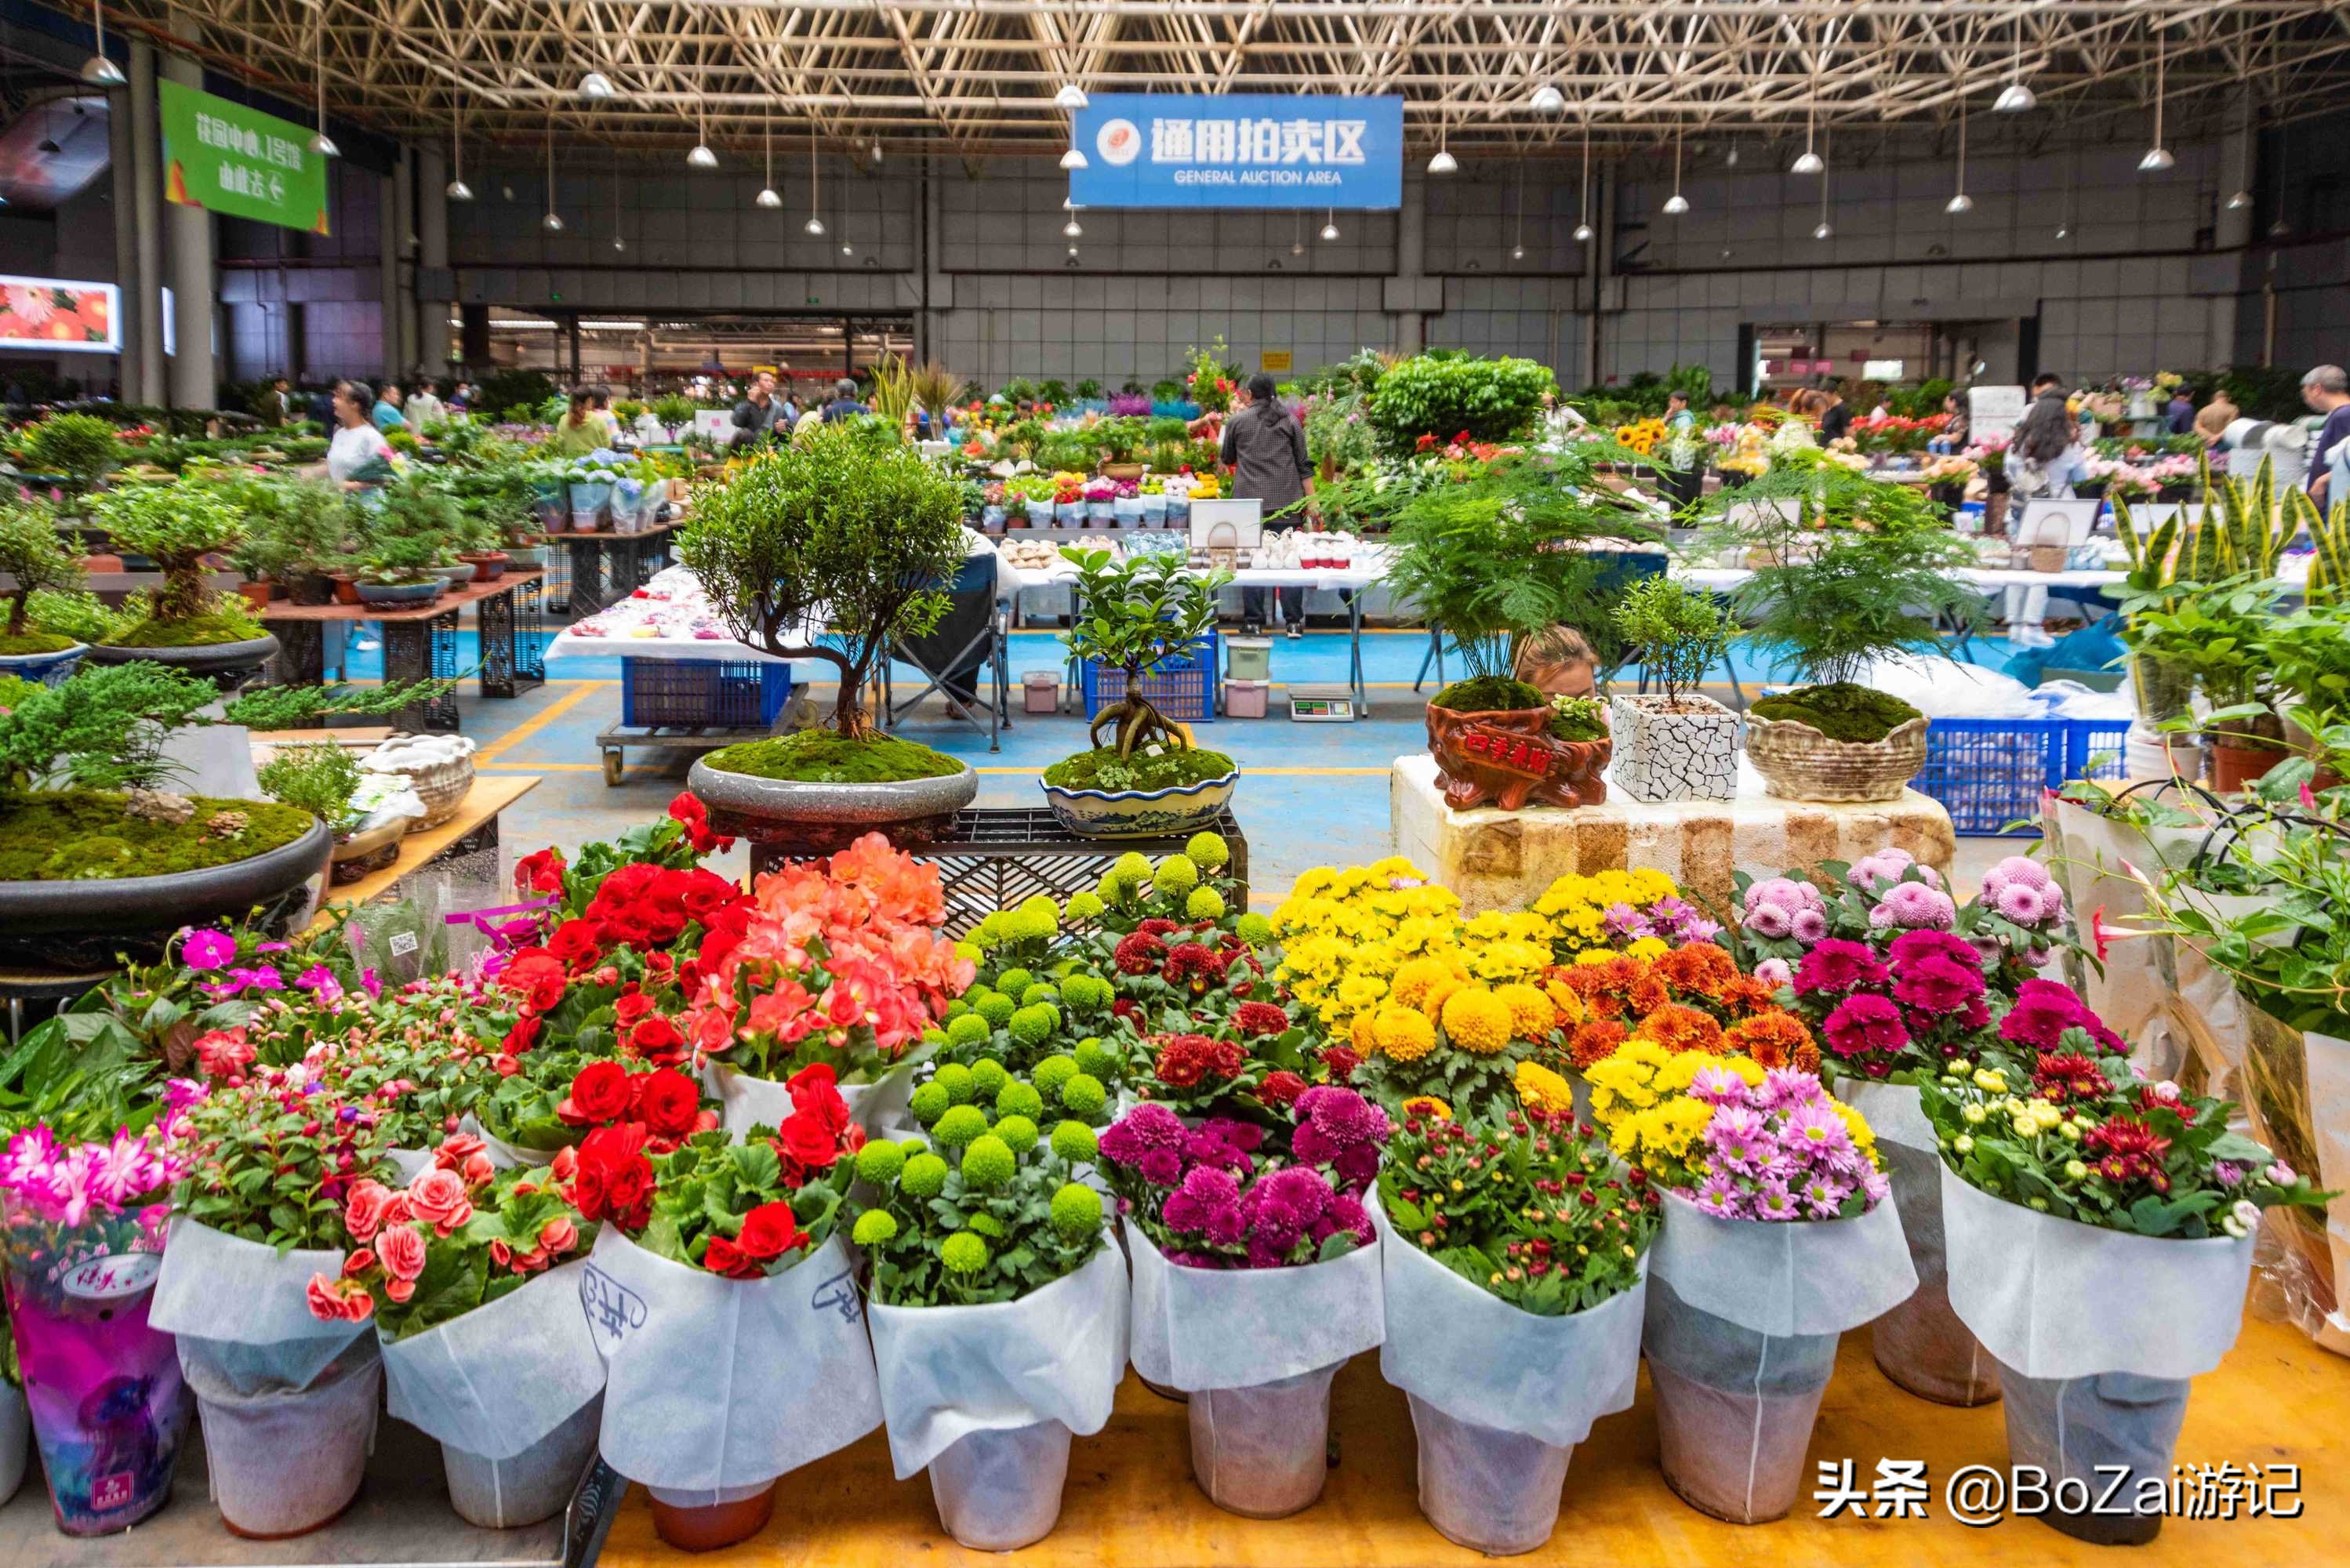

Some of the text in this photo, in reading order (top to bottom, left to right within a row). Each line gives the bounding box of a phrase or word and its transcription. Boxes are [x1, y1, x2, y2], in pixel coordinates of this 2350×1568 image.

[1151, 118, 1368, 165] 通用拍卖区
[1174, 169, 1342, 185] GENERAL AUCTION AREA
